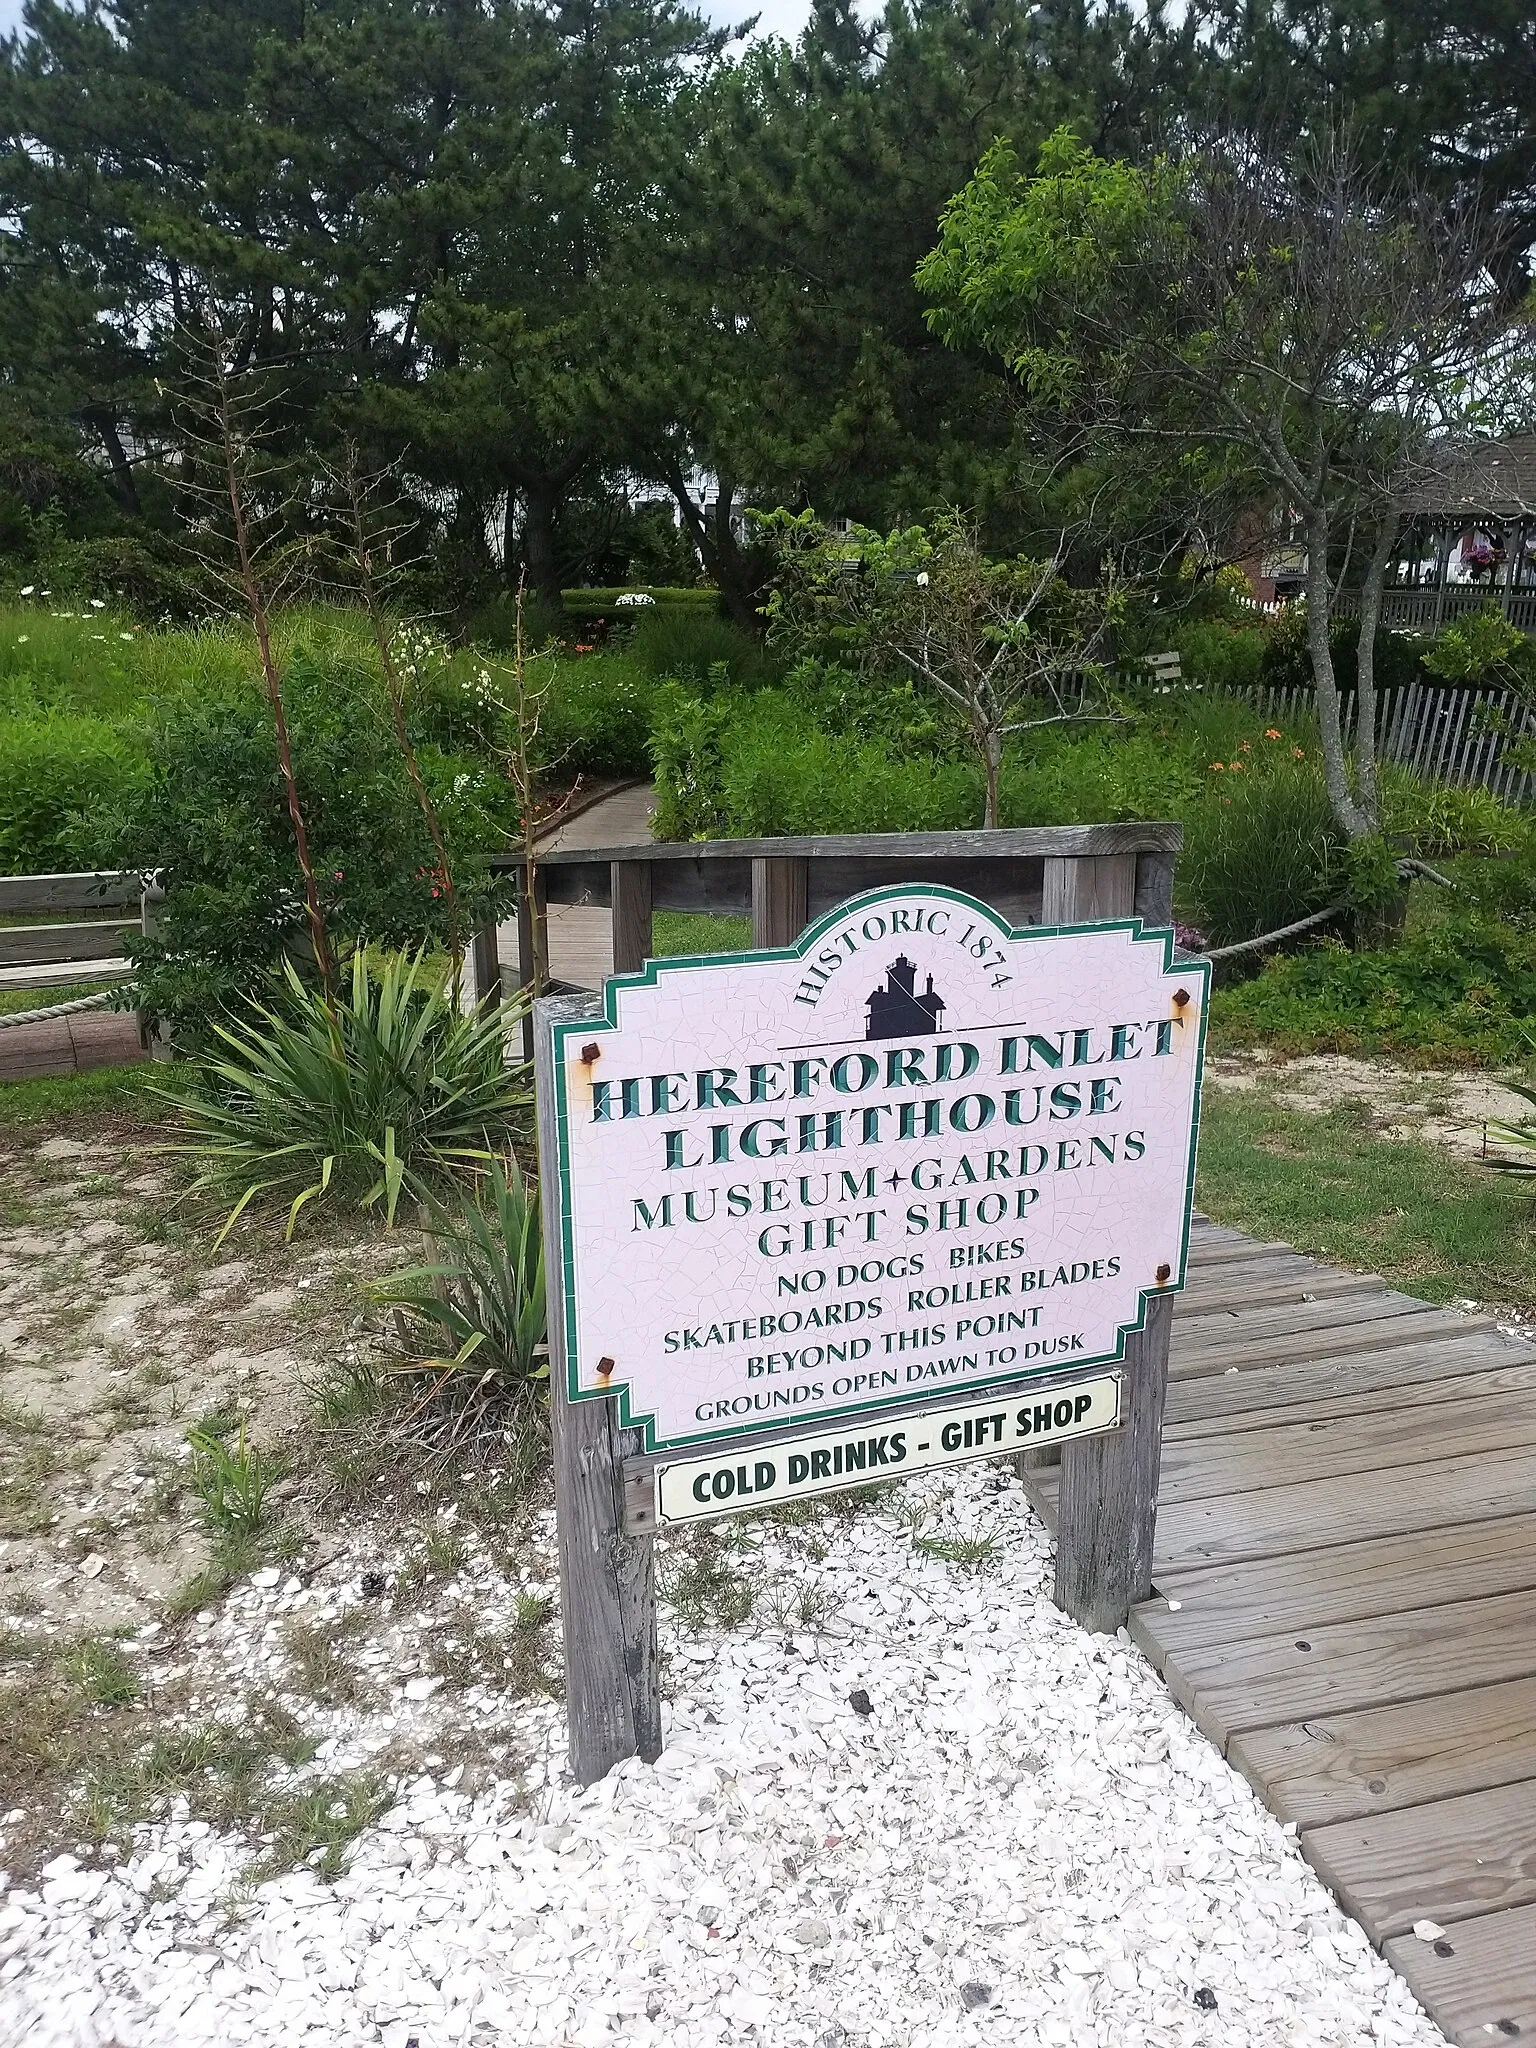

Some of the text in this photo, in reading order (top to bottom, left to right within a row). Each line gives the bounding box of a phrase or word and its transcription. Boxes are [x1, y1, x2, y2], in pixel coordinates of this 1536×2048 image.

[794, 908, 1013, 1008] HISTORIC 1874
[588, 1017, 1184, 1123] HEREFORD INLET
[661, 1076, 1123, 1171] LIGHTHOUSE
[758, 1188, 1041, 1258] GIFT SHOP
[777, 1237, 1026, 1298] NO DOGS BIKES
[663, 1255, 1122, 1355] SKATEBOARDS ROLLER BLADES
[746, 1305, 1044, 1379] BEYOND THIS POINT
[695, 1332, 1085, 1422] GROUNDS OPEN DAWN TO DUSK
[692, 1460, 777, 1503] COLD
[787, 1432, 907, 1484] DRINKS
[941, 1412, 1007, 1452] GIFT
[1016, 1394, 1092, 1436] SHOP
